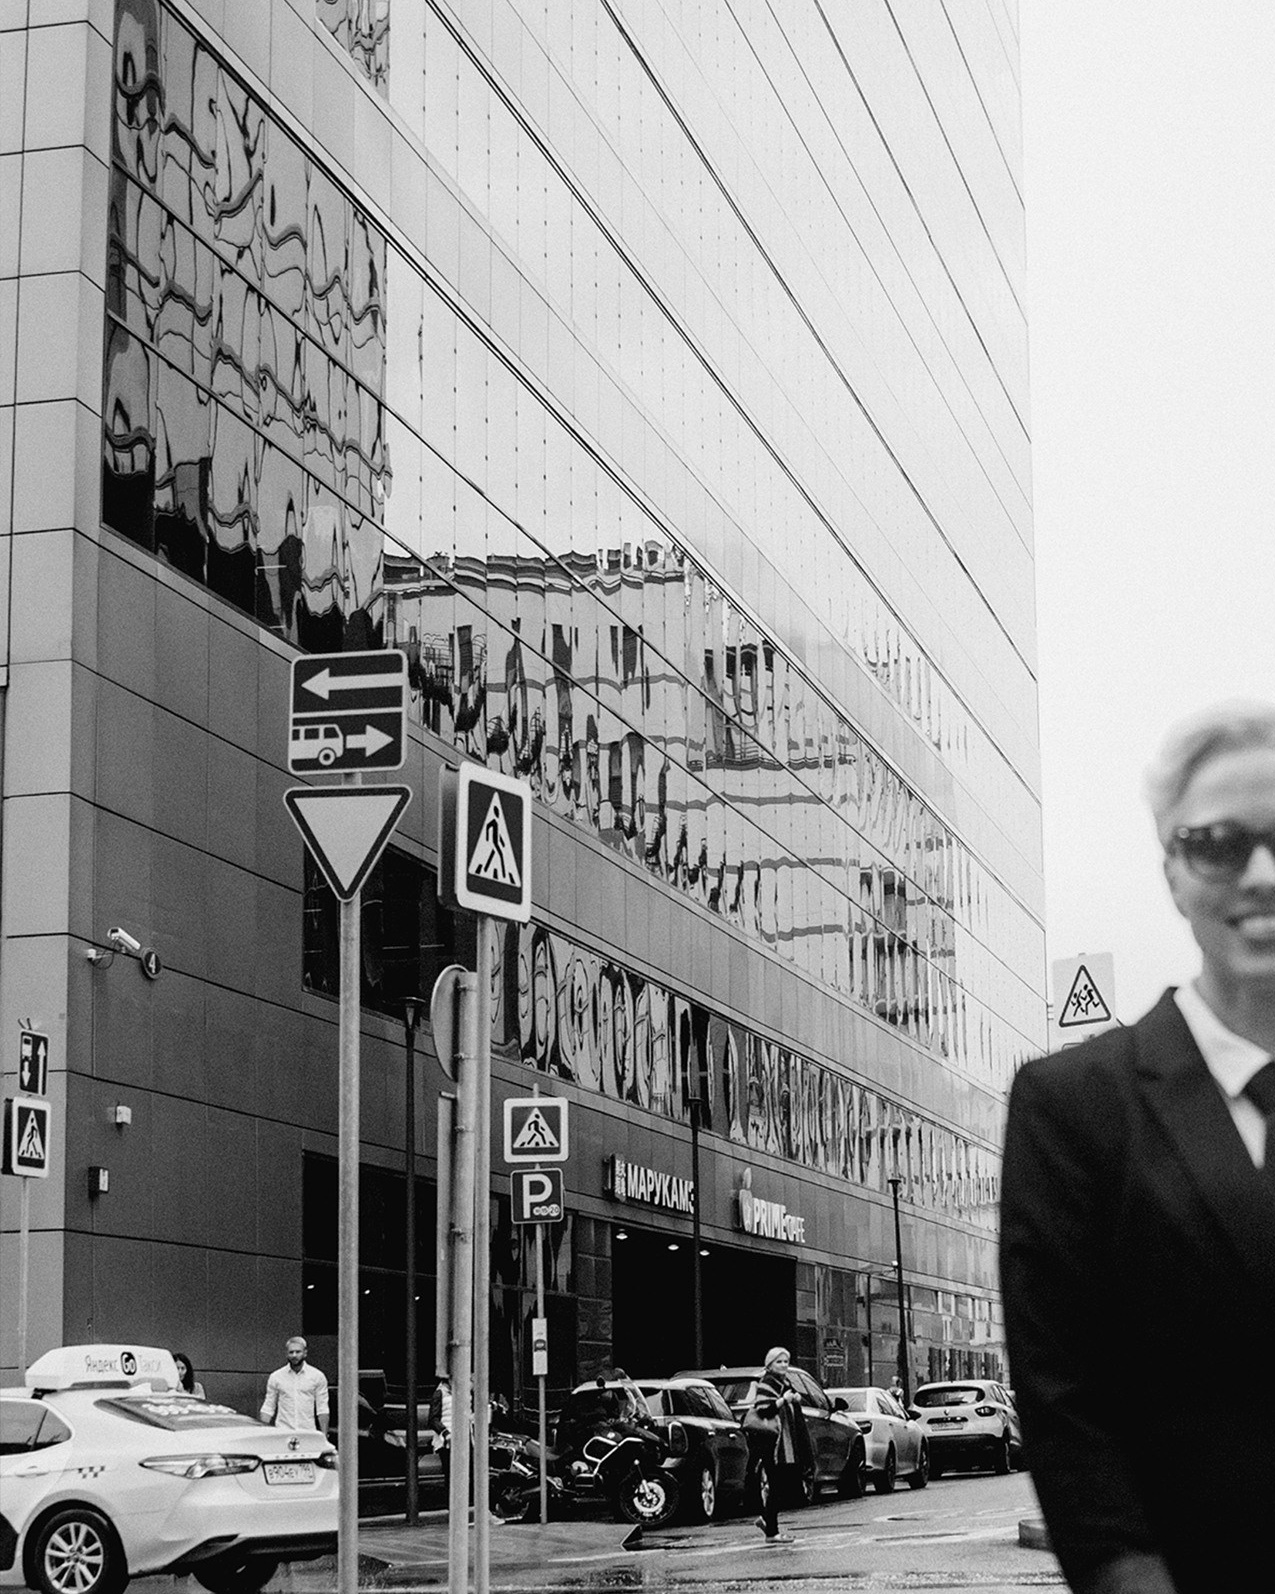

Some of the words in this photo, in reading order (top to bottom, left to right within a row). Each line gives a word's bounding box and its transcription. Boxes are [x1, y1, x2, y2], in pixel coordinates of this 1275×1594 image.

[148, 953, 156, 974] 4
[523, 1174, 552, 1218] P
[753, 1198, 786, 1240] PRIME
[85, 1355, 119, 1373] Яндекс
